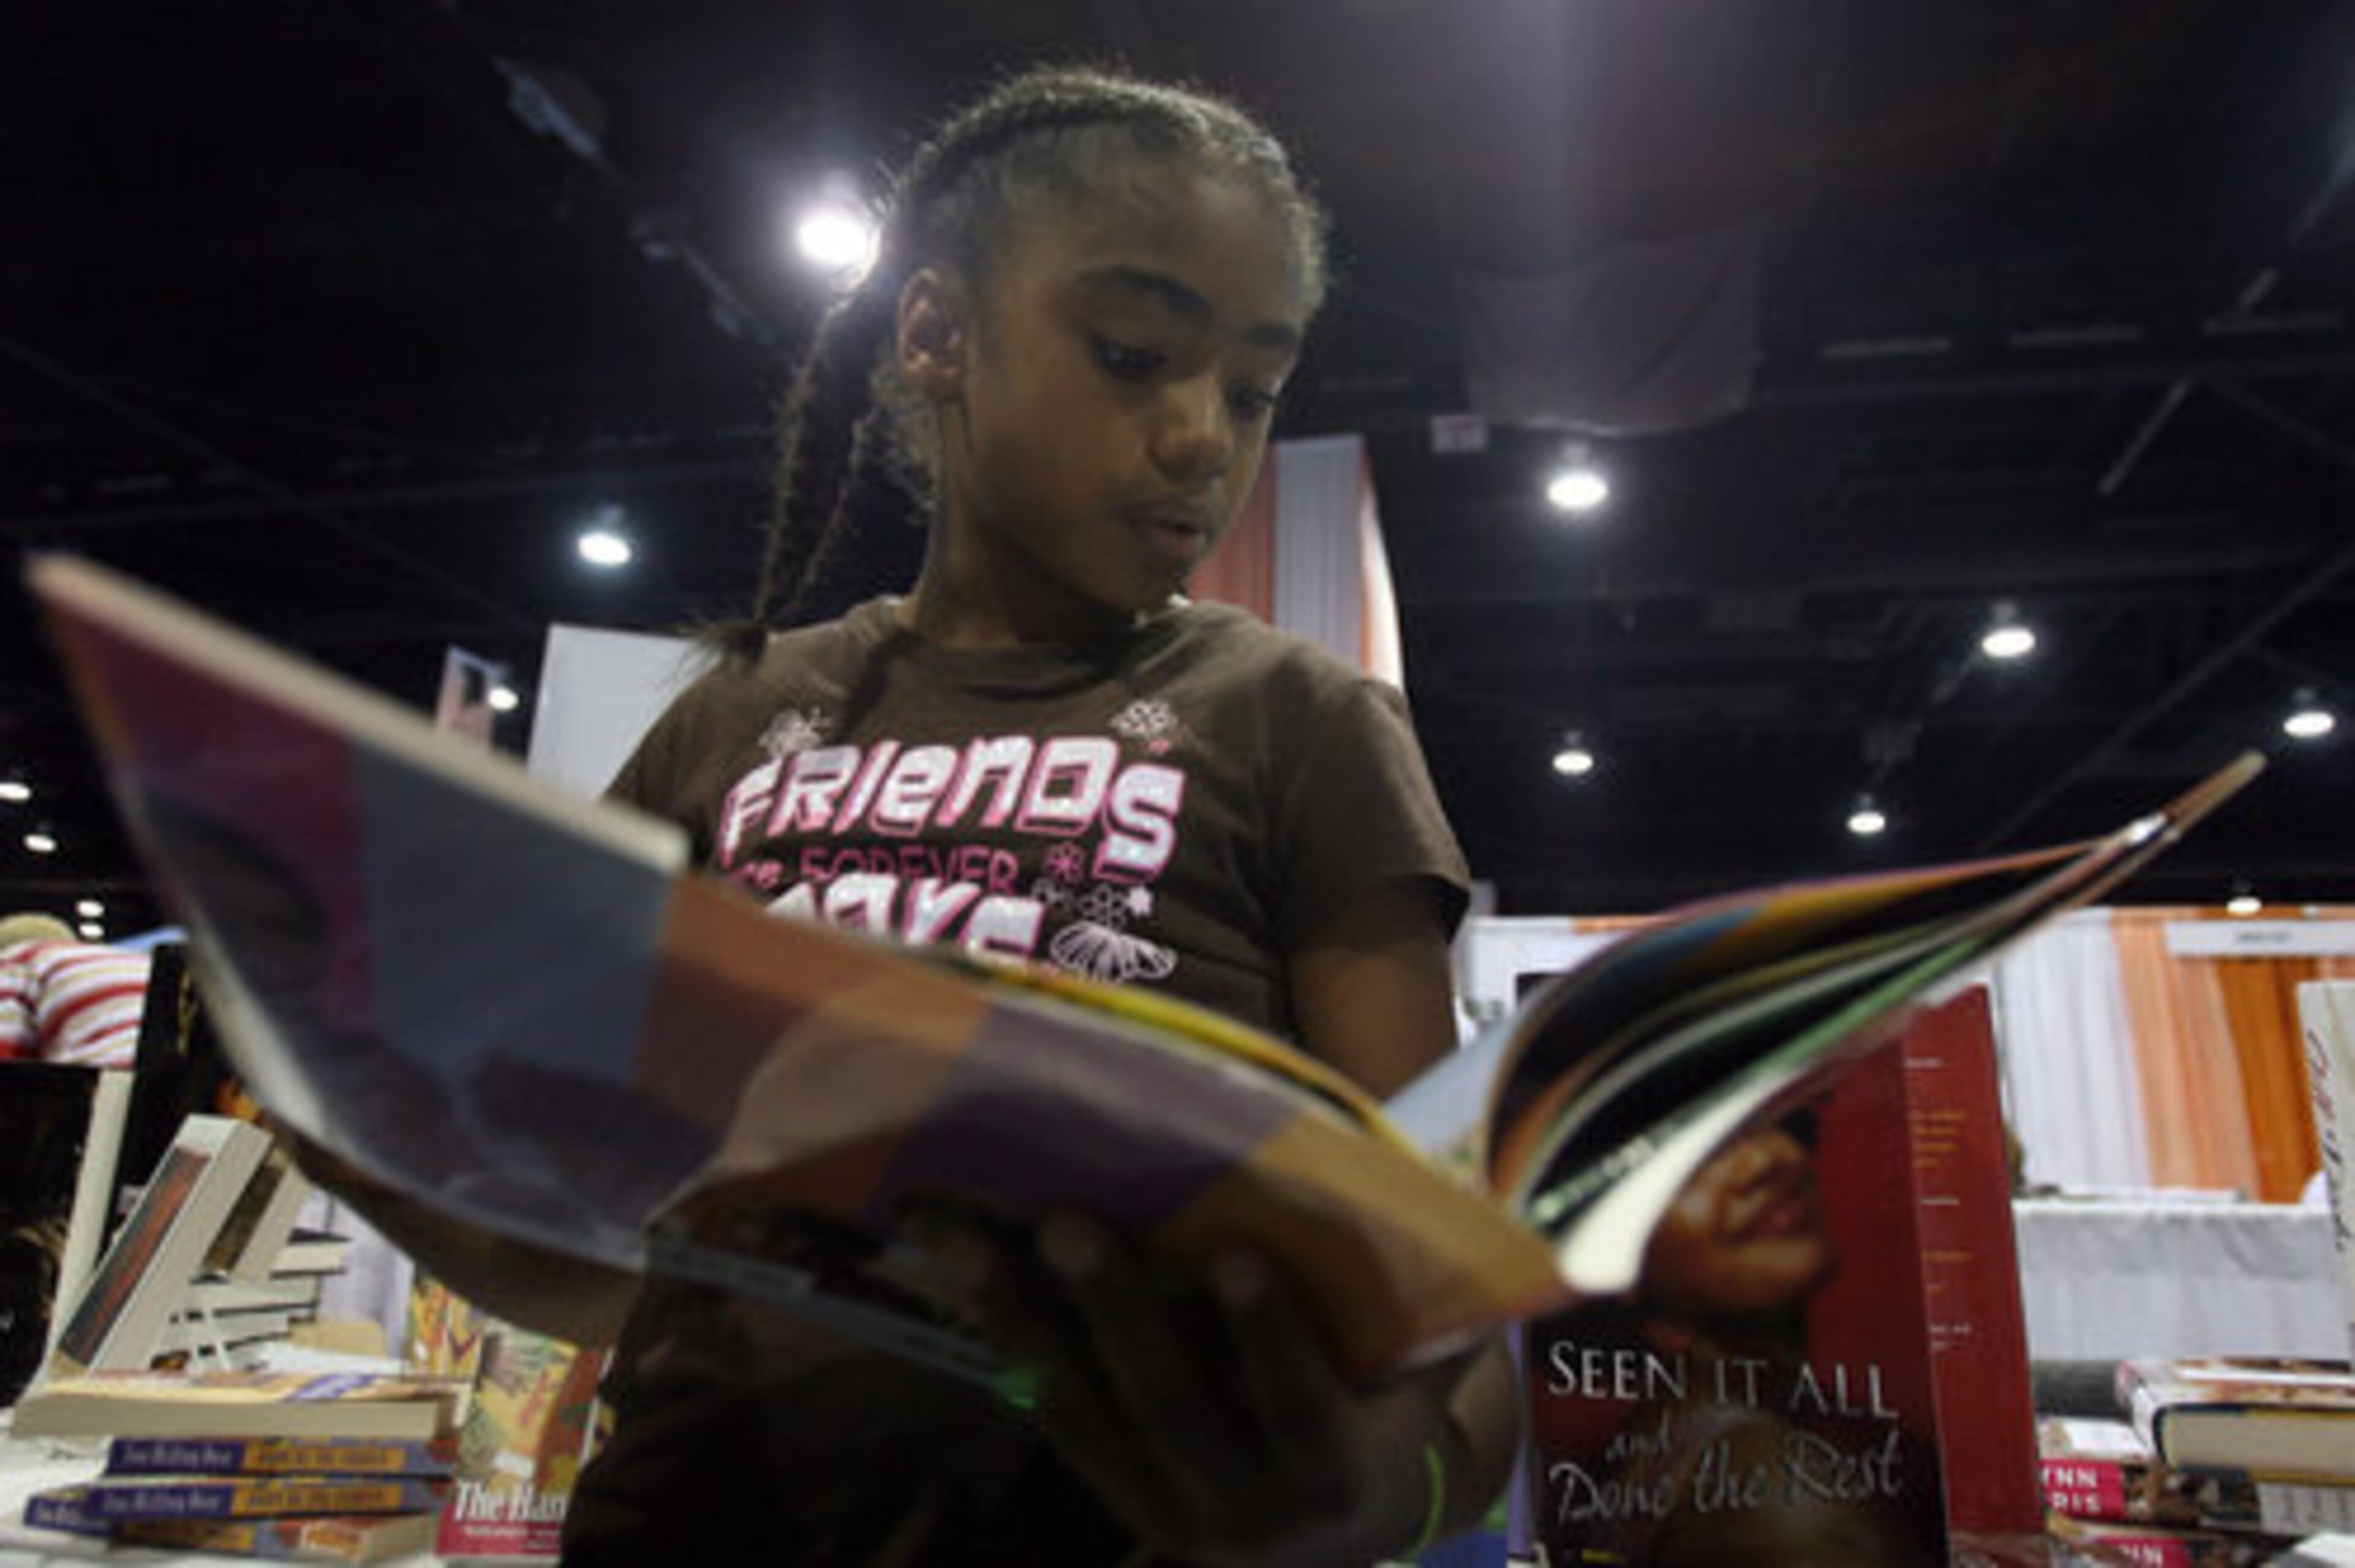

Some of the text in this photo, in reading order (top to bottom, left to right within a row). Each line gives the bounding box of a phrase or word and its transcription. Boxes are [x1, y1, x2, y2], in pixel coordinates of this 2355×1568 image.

[1547, 1340, 1900, 1418] SEEN IT ALL
[1605, 1412, 1669, 1462] and
[454, 1479, 498, 1523] The
[1549, 1429, 1901, 1526] Done the Rest
